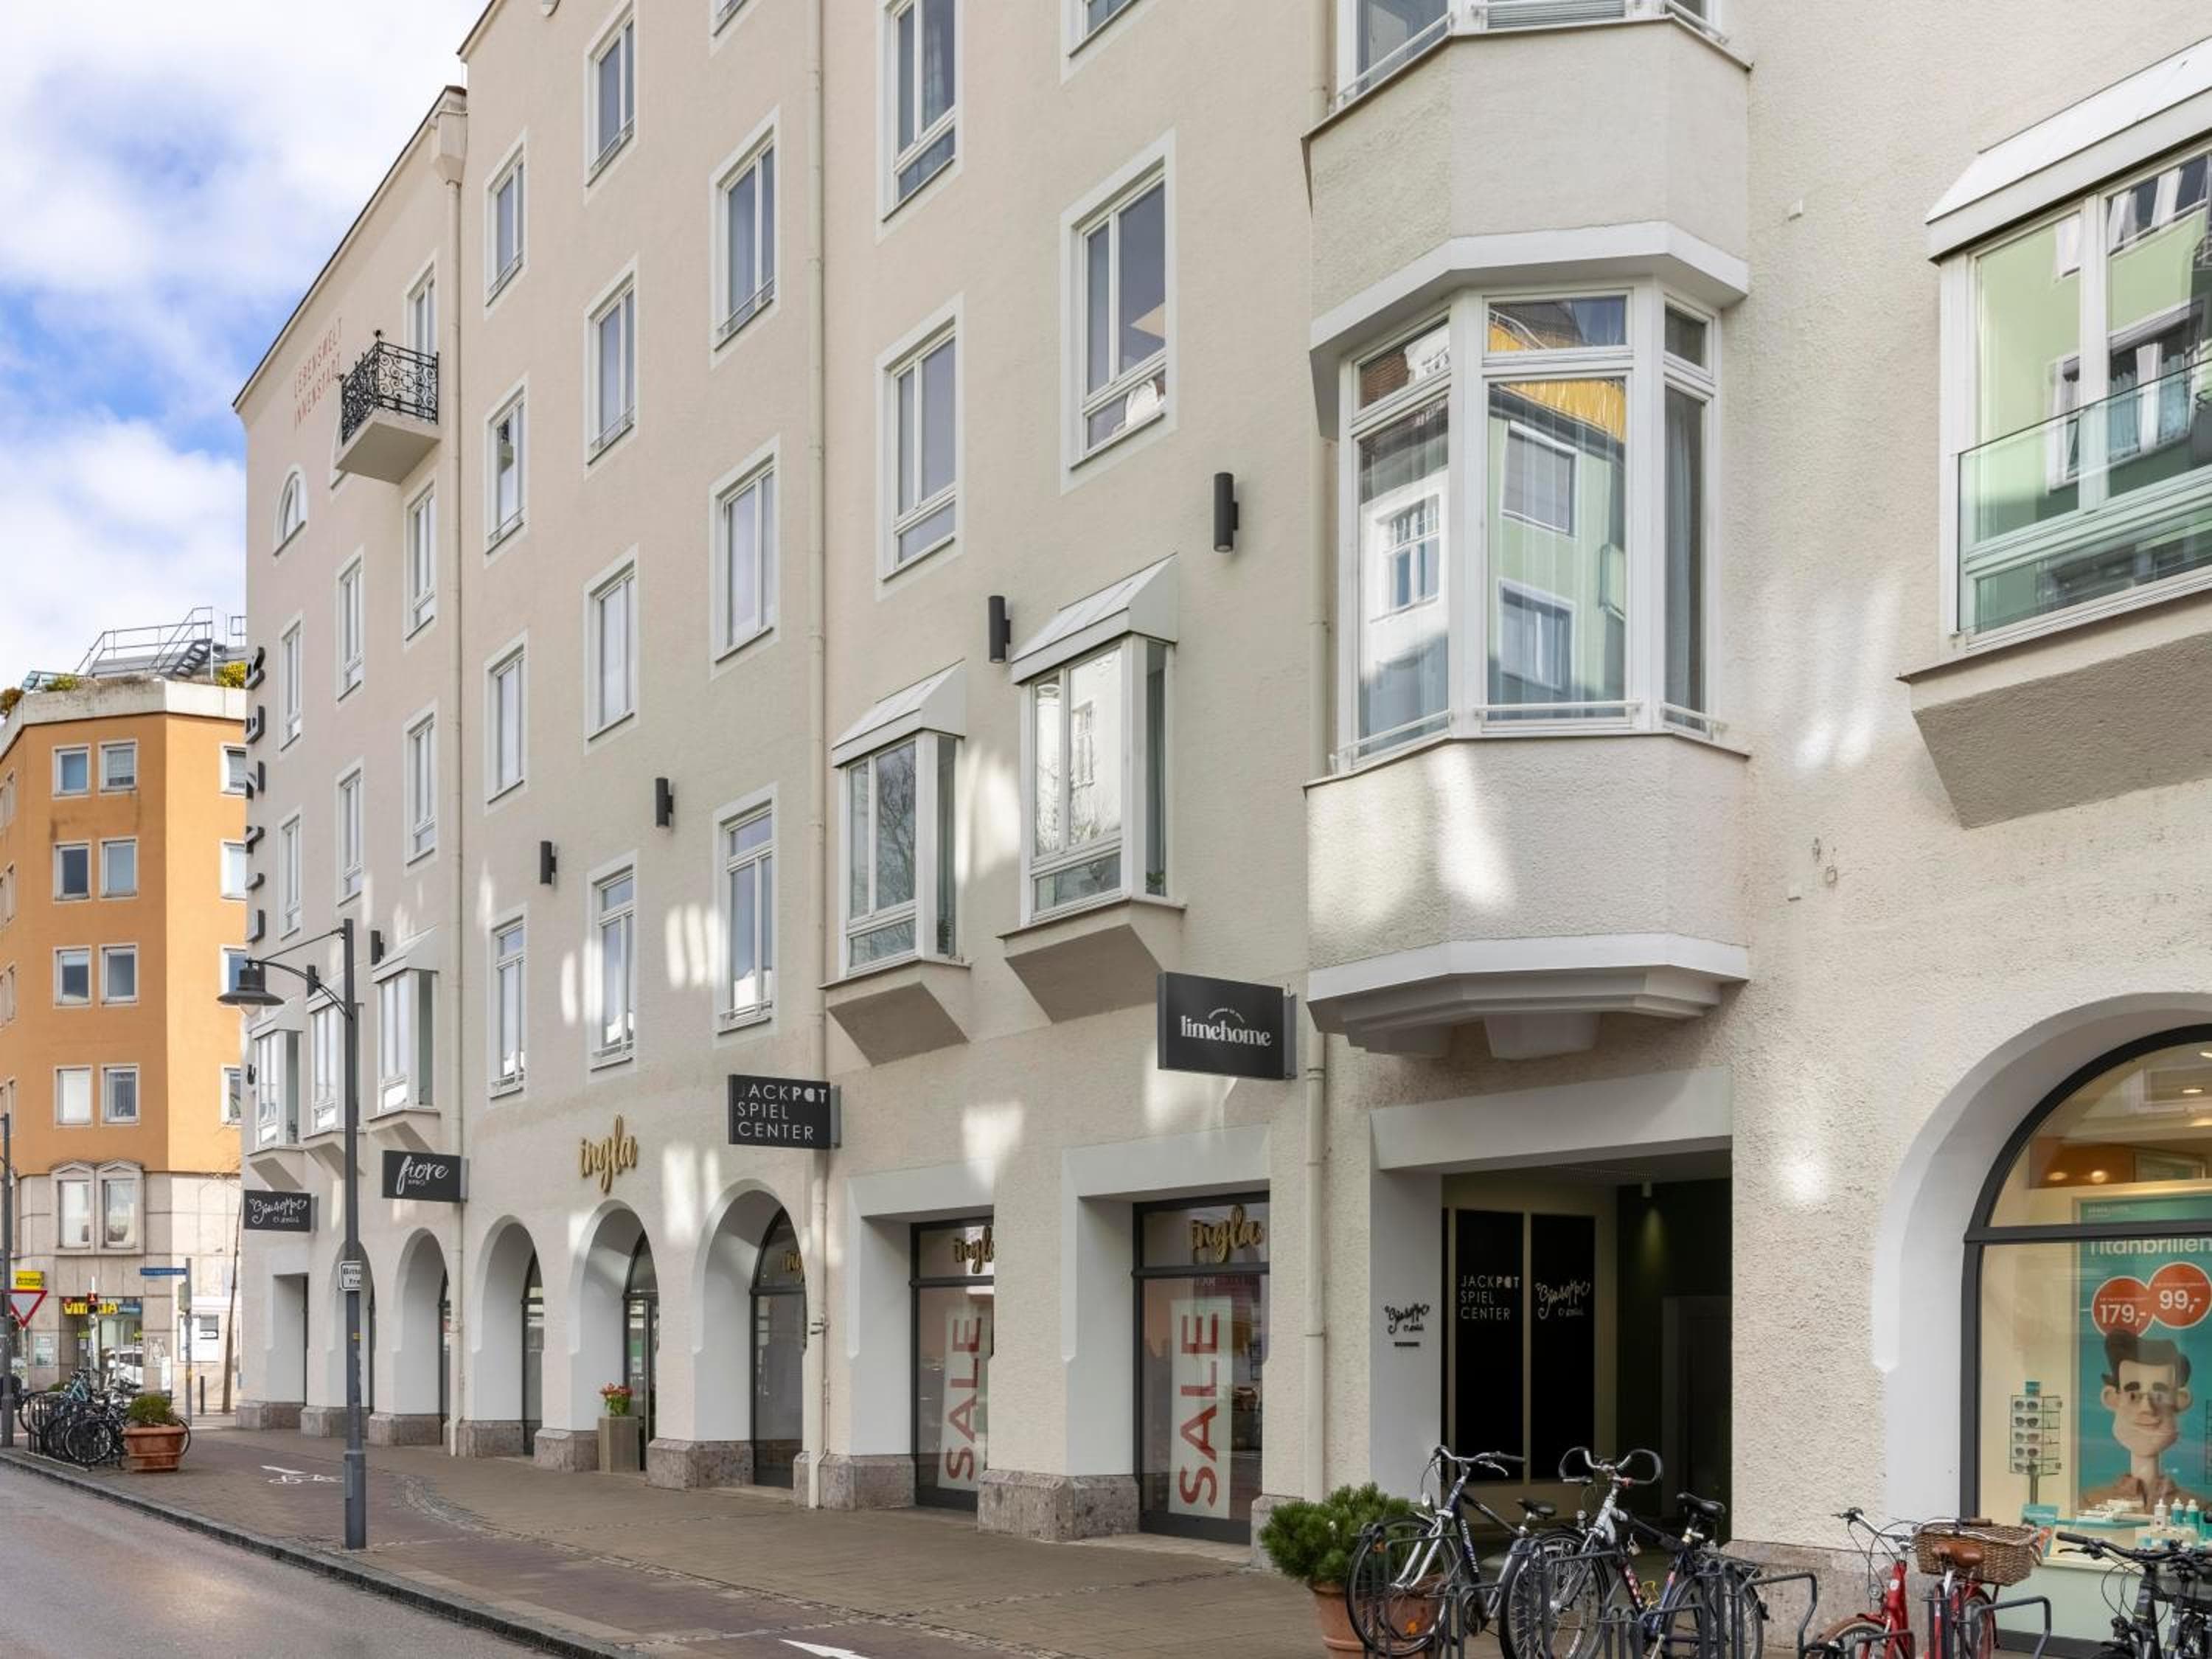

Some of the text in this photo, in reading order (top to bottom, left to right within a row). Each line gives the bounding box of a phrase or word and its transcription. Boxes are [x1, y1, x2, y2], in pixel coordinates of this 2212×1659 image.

[1180, 1015, 1272, 1046] limehome
[737, 1083, 827, 1104] JACKPOT
[737, 1101, 789, 1120] SPIEL
[738, 1121, 814, 1141] CENTER
[579, 1114, 638, 1196] ingla
[396, 1155, 449, 1195] fiore
[1192, 1203, 1263, 1263] ingla
[1460, 1276, 1520, 1289] JACKPOT
[1460, 1290, 1495, 1304] SPIEL
[2159, 1290, 2202, 1313] 99,-
[1460, 1307, 1510, 1321] CENTER
[2100, 1303, 2146, 1326] 179,-
[946, 1317, 982, 1481] SALE
[1180, 1313, 1218, 1508] SALE
